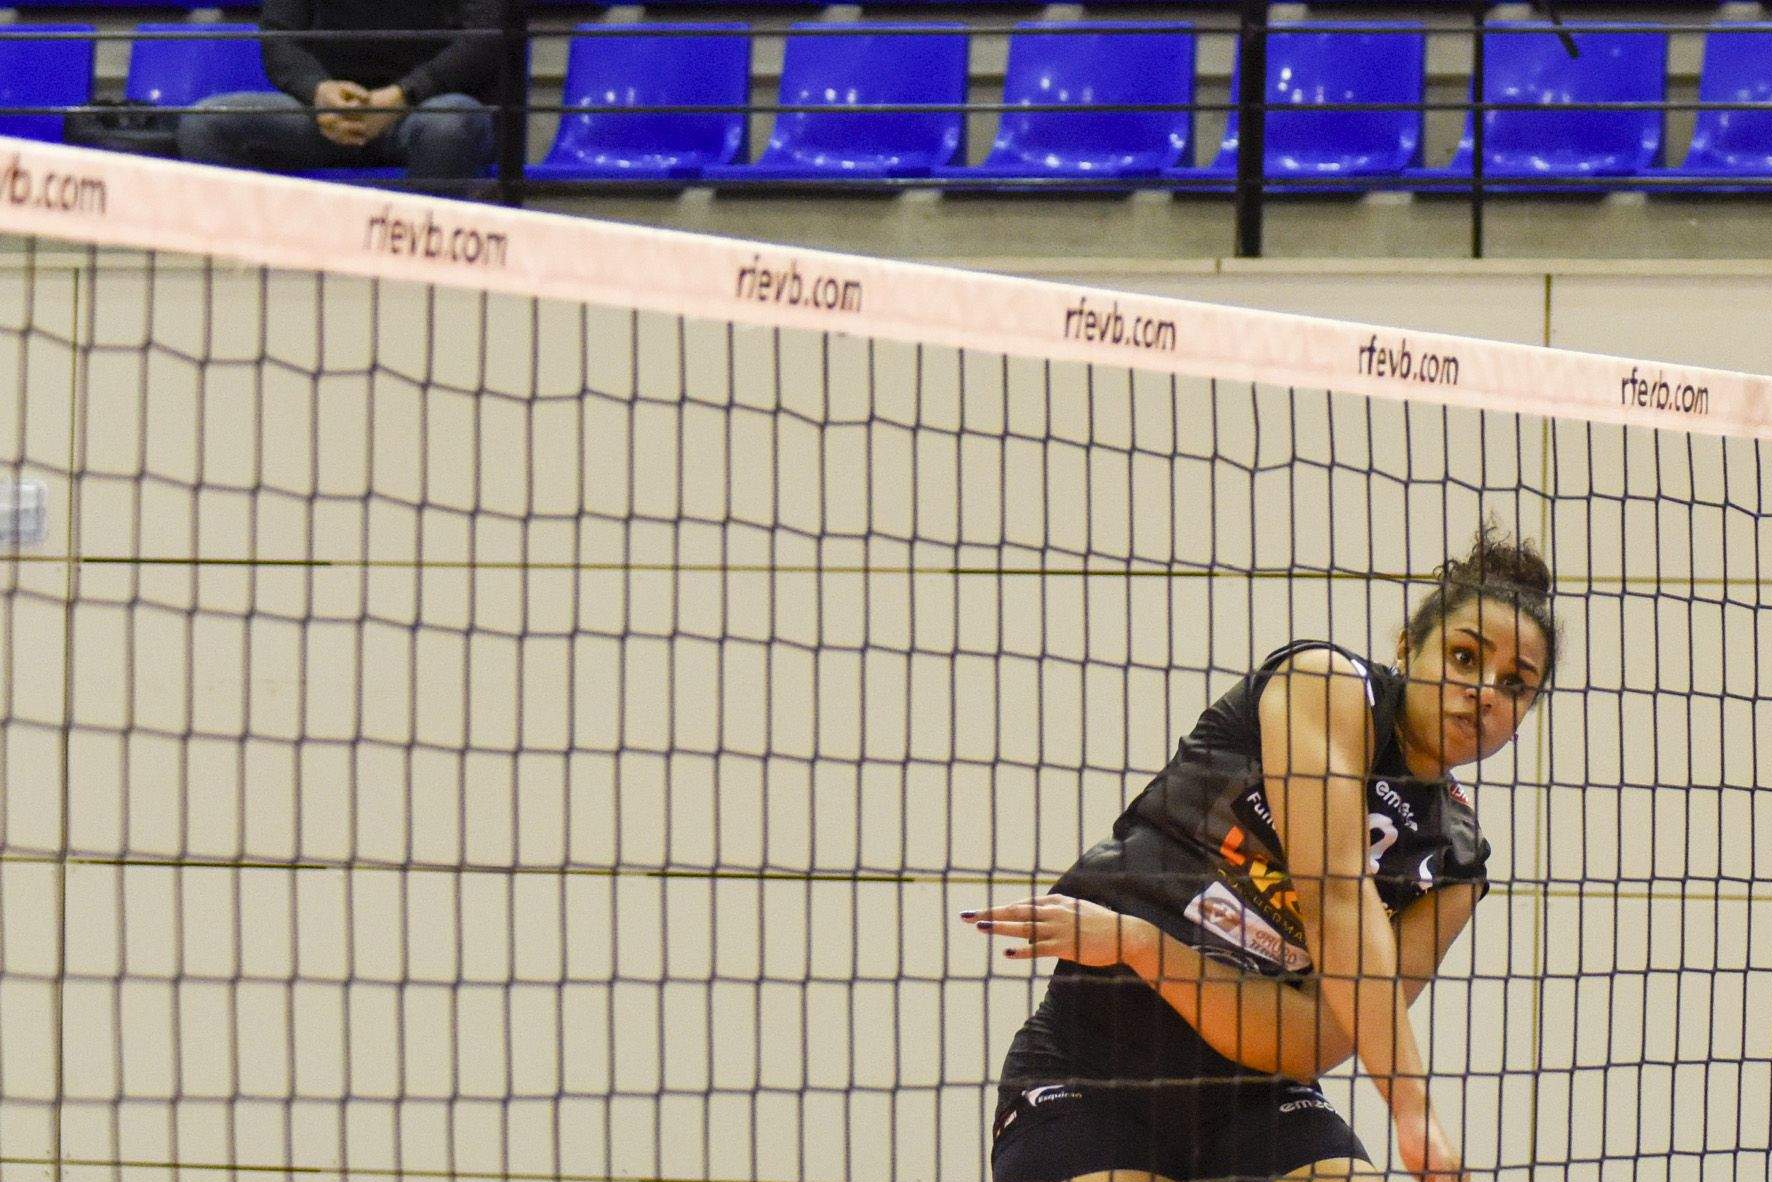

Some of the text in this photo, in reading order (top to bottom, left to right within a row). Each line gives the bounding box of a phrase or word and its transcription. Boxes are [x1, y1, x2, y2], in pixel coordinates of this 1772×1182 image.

[736, 253, 863, 313] rfevb.com
[1064, 296, 1177, 350] rfevb.com
[1359, 333, 1459, 385] rfevb.com
